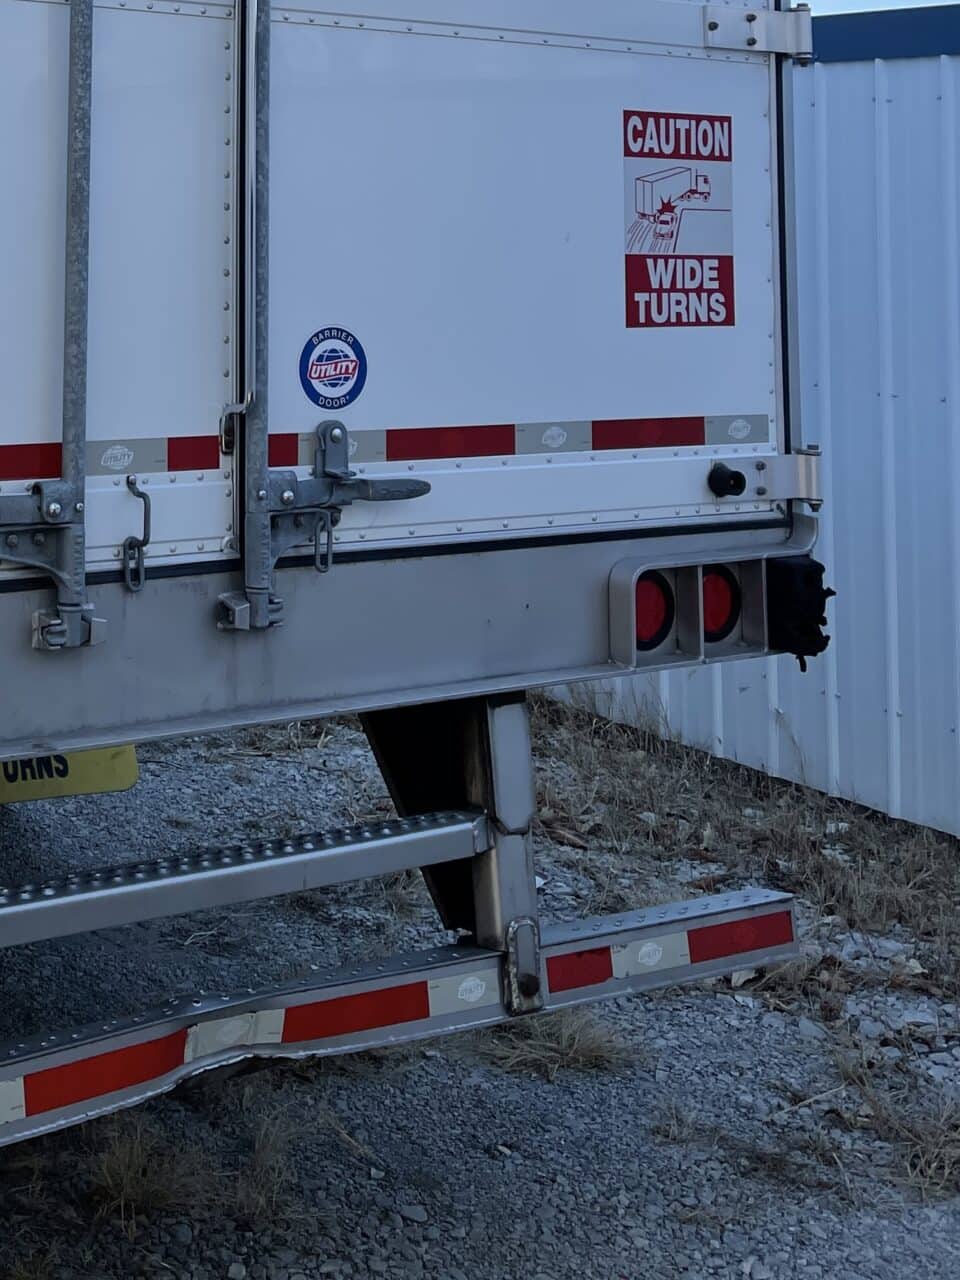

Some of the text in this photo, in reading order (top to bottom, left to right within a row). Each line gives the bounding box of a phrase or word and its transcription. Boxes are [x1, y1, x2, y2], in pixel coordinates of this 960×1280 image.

[627, 115, 729, 157] CAUTION
[646, 258, 720, 289] WIDE
[634, 292, 727, 324] TURNS
[312, 329, 354, 345] BARRIER
[310, 361, 357, 378] UTILITY
[318, 396, 347, 407] DOOR
